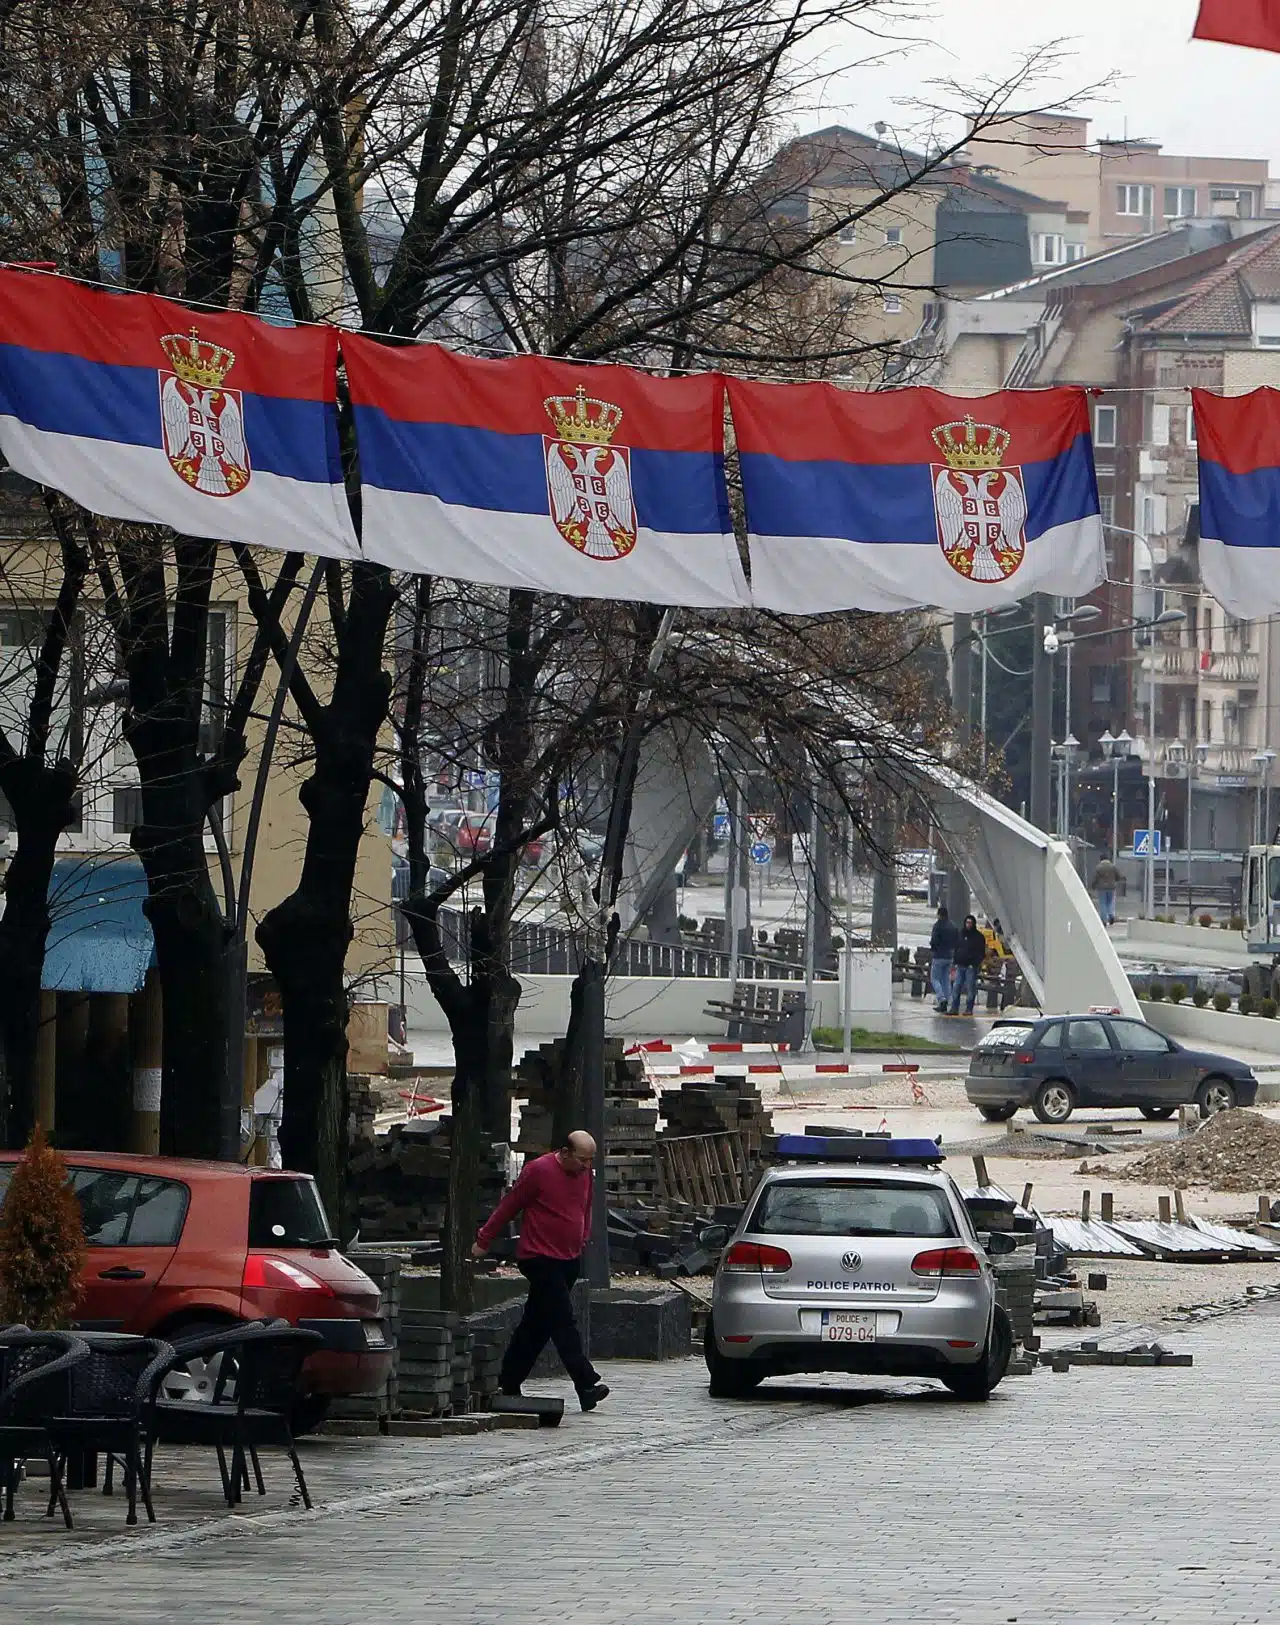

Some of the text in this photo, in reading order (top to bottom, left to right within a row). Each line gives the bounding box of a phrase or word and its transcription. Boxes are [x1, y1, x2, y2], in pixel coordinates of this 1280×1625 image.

[807, 1280, 849, 1290] POLICE
[853, 1281, 897, 1292] PATROL
[836, 1314, 860, 1323] POLICE
[828, 1326, 874, 1341] 079-04
